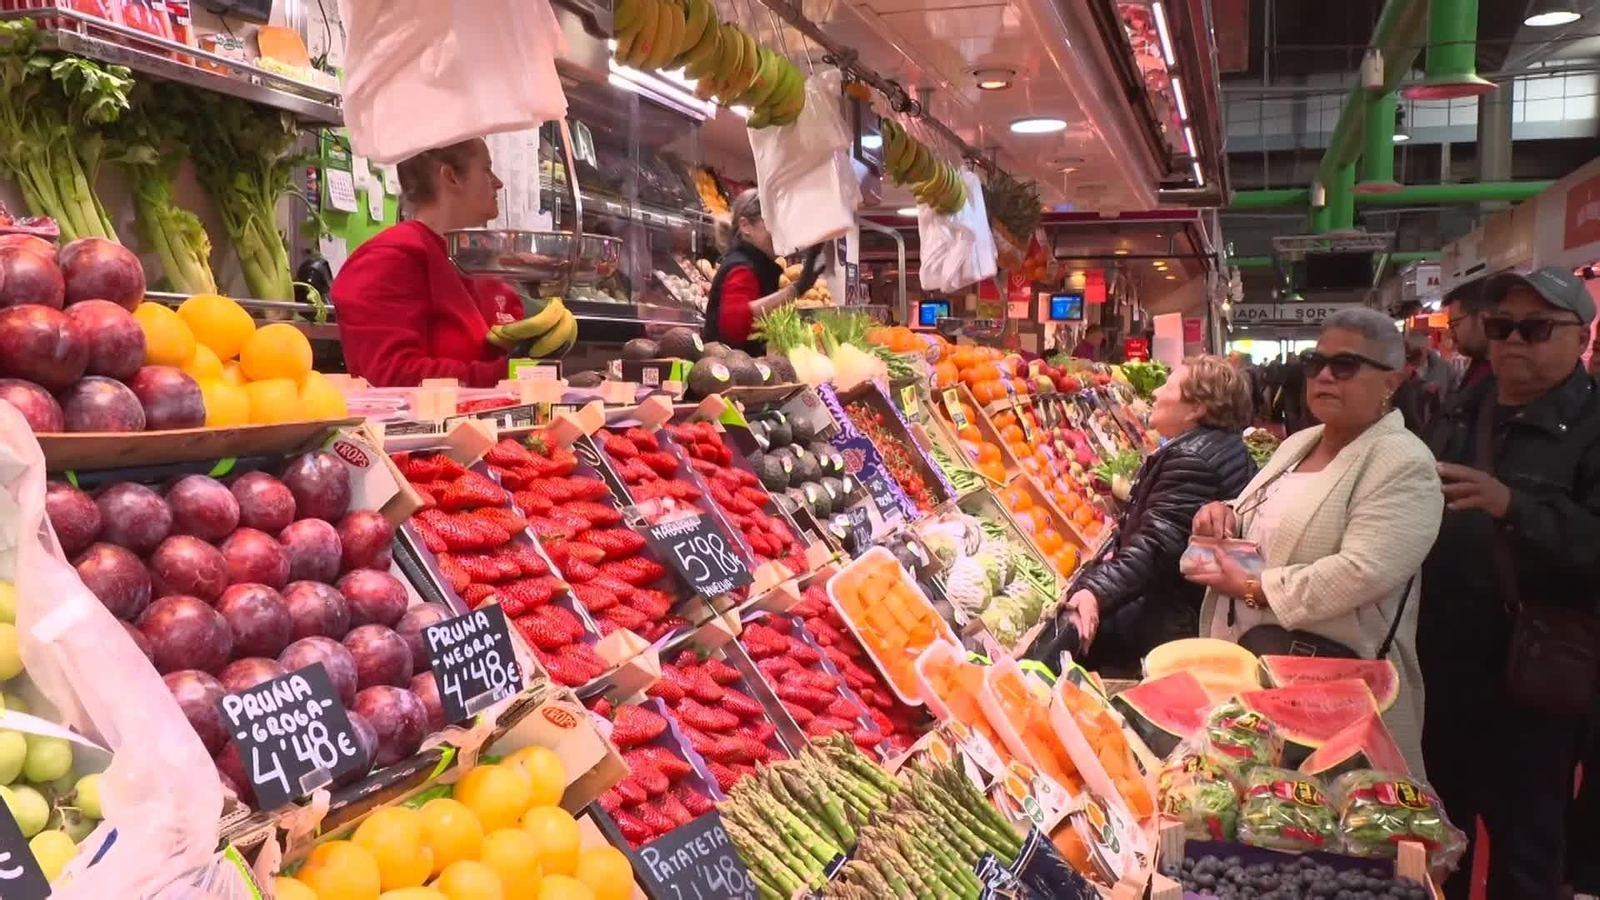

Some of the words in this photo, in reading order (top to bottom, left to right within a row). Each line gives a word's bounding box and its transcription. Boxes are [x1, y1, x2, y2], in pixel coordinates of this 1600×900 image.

[335, 443, 368, 467] TROPS
[673, 533, 738, 582] 5'98
[427, 611, 490, 653] PRUNA
[222, 674, 312, 726] PRUNA
